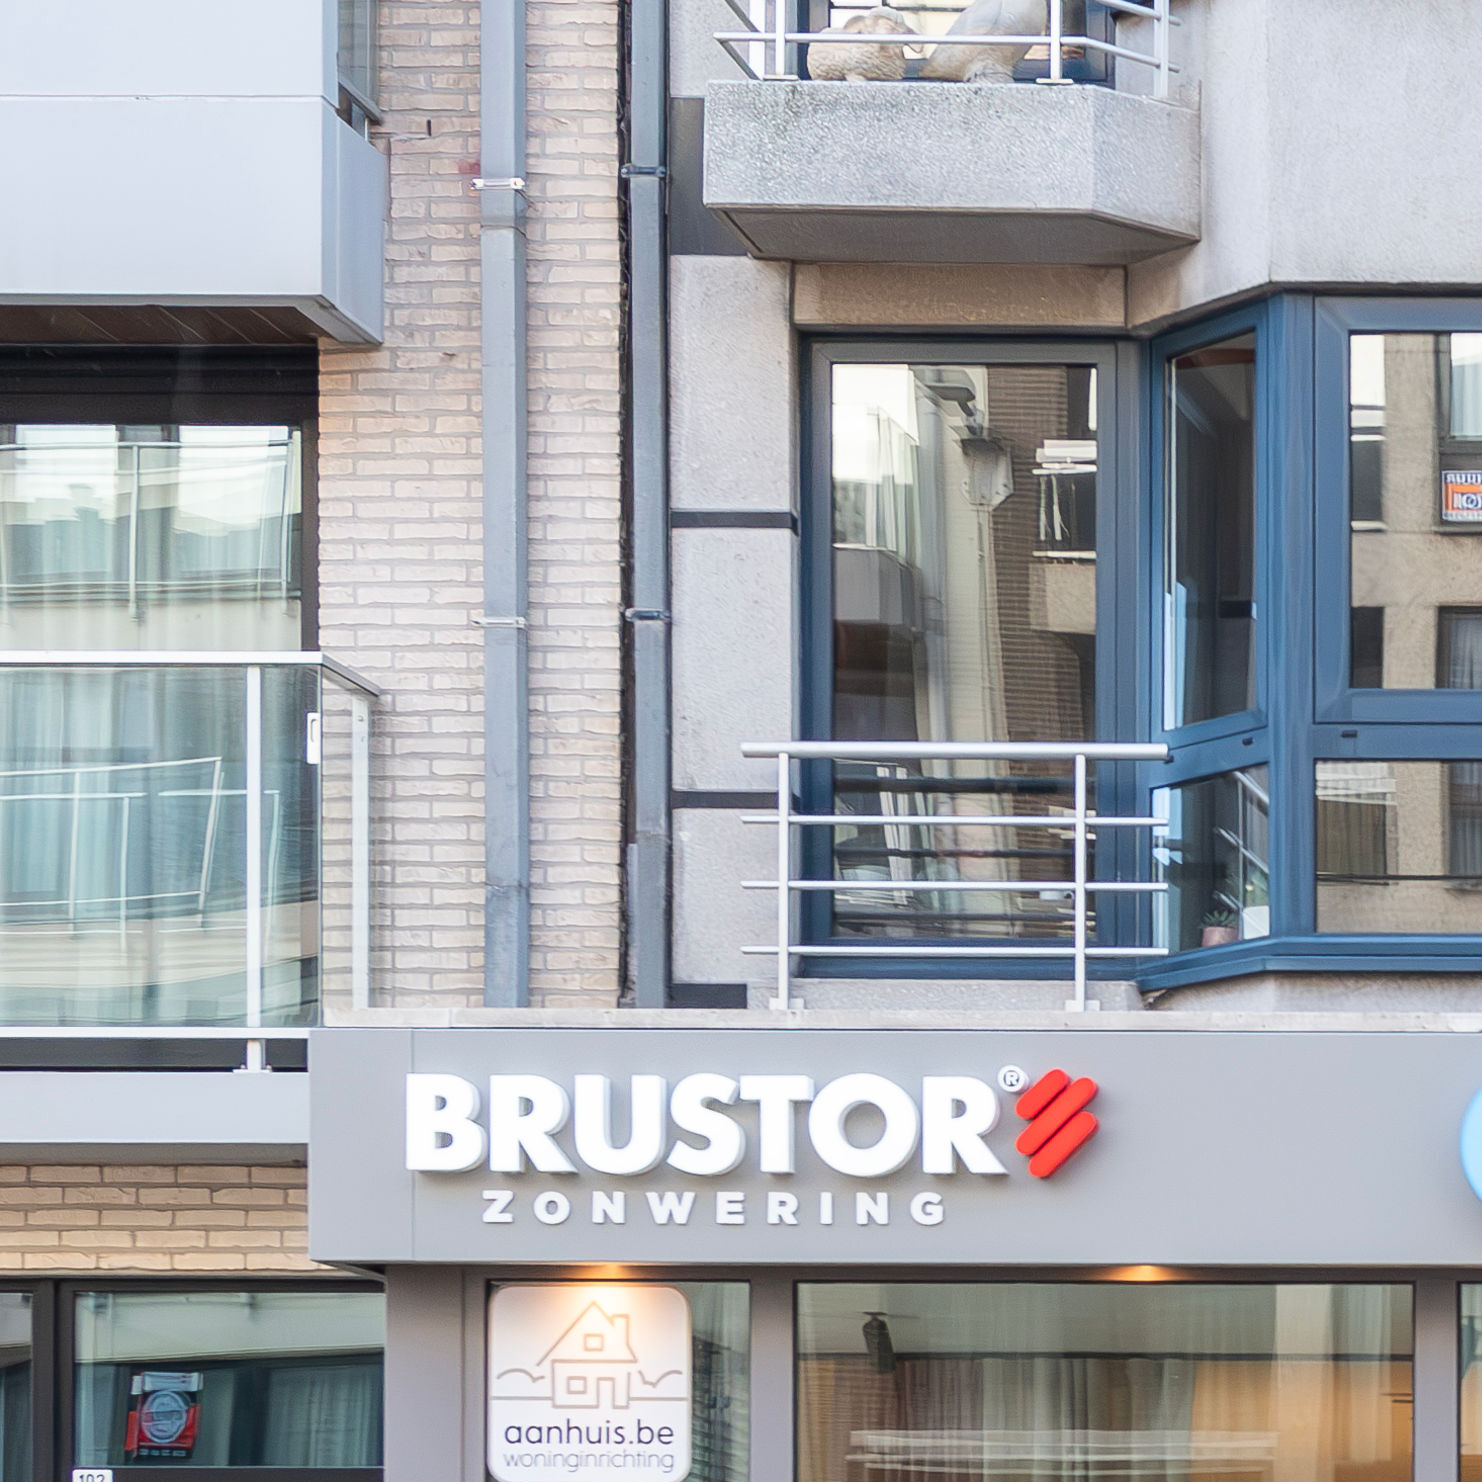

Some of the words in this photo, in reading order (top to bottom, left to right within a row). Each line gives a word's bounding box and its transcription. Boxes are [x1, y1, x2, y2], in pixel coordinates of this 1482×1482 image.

[482, 1189, 945, 1227] ZONWERING
[504, 1418, 674, 1445] aanhuis.be
[503, 1449, 674, 1473] woninginrichting
